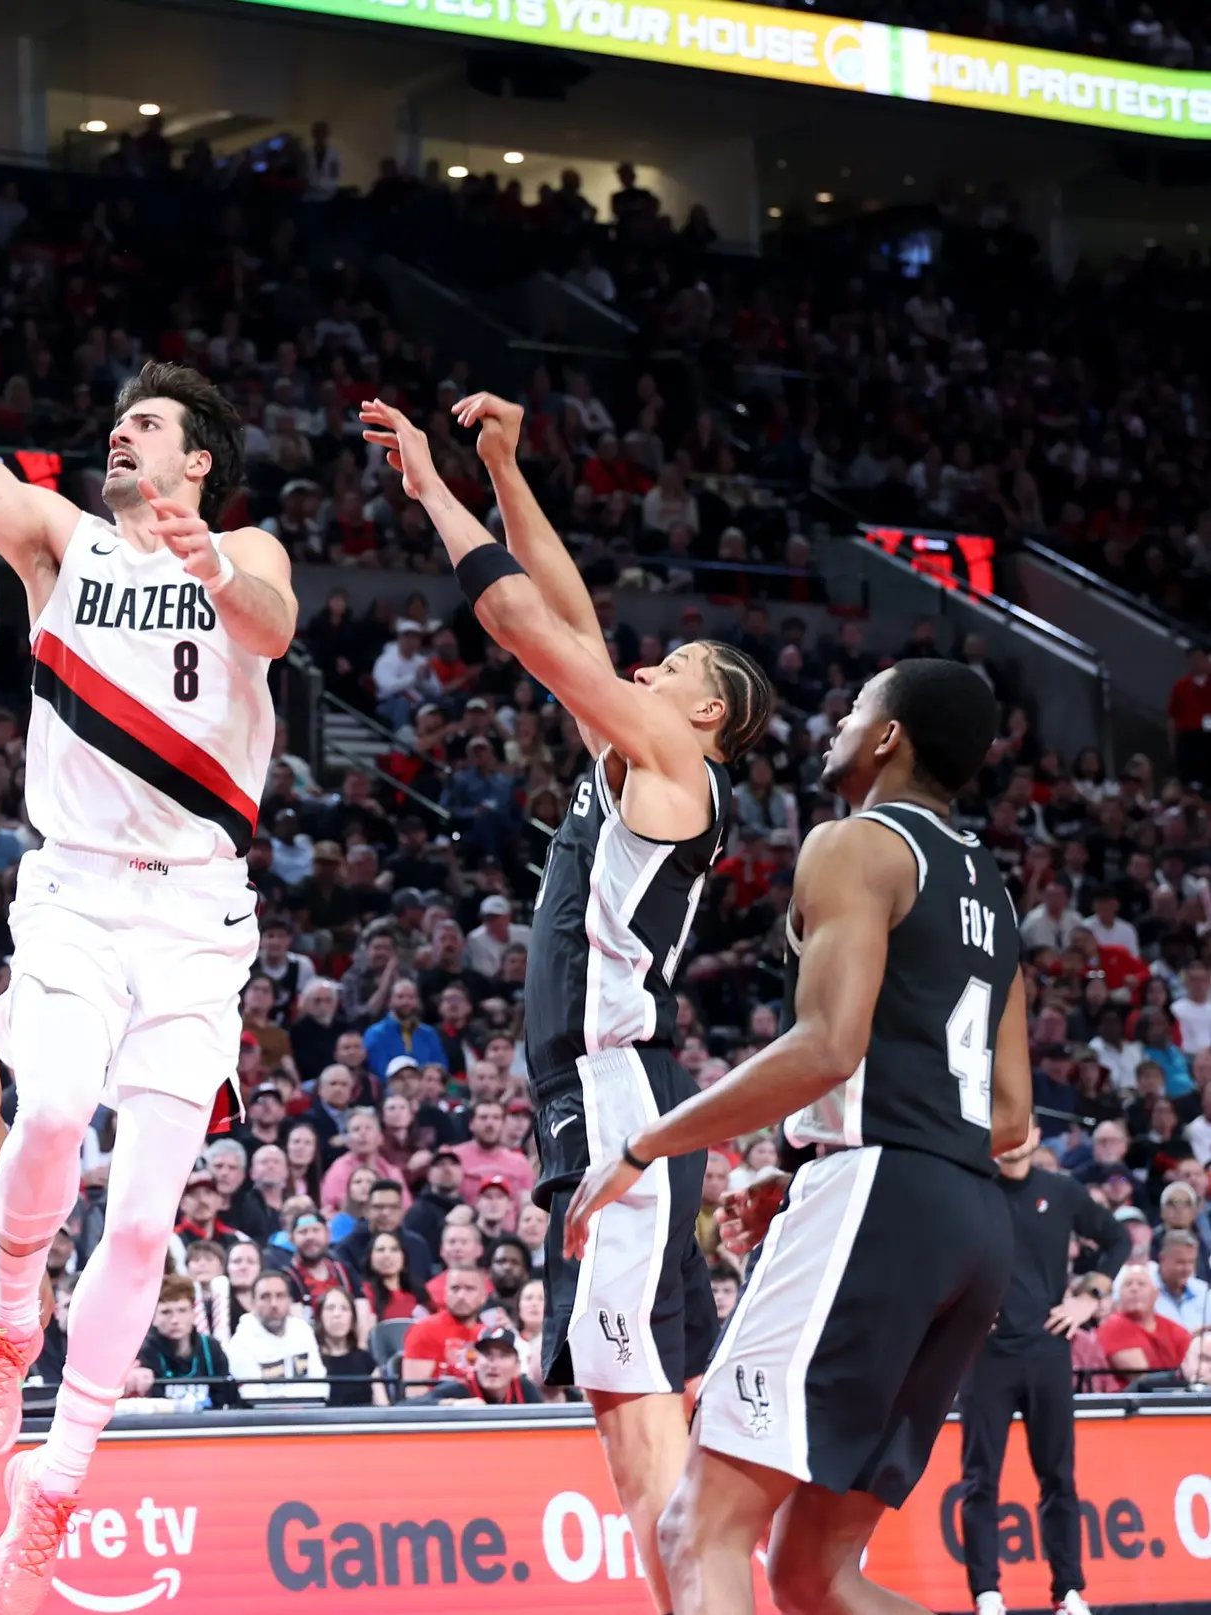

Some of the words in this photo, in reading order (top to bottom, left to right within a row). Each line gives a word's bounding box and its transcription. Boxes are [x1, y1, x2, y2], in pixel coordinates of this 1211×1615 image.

[554, 0, 671, 46] YOUR
[678, 12, 820, 68] HOUSE
[1017, 64, 1211, 124] PROTECTS
[75, 577, 216, 632] BLAZERS
[174, 640, 199, 702] 8
[129, 857, 169, 876] ripcity
[959, 896, 995, 957] FOX
[945, 975, 992, 1130] 4
[135, 1497, 198, 1557] tv
[267, 1500, 530, 1591] Game.
